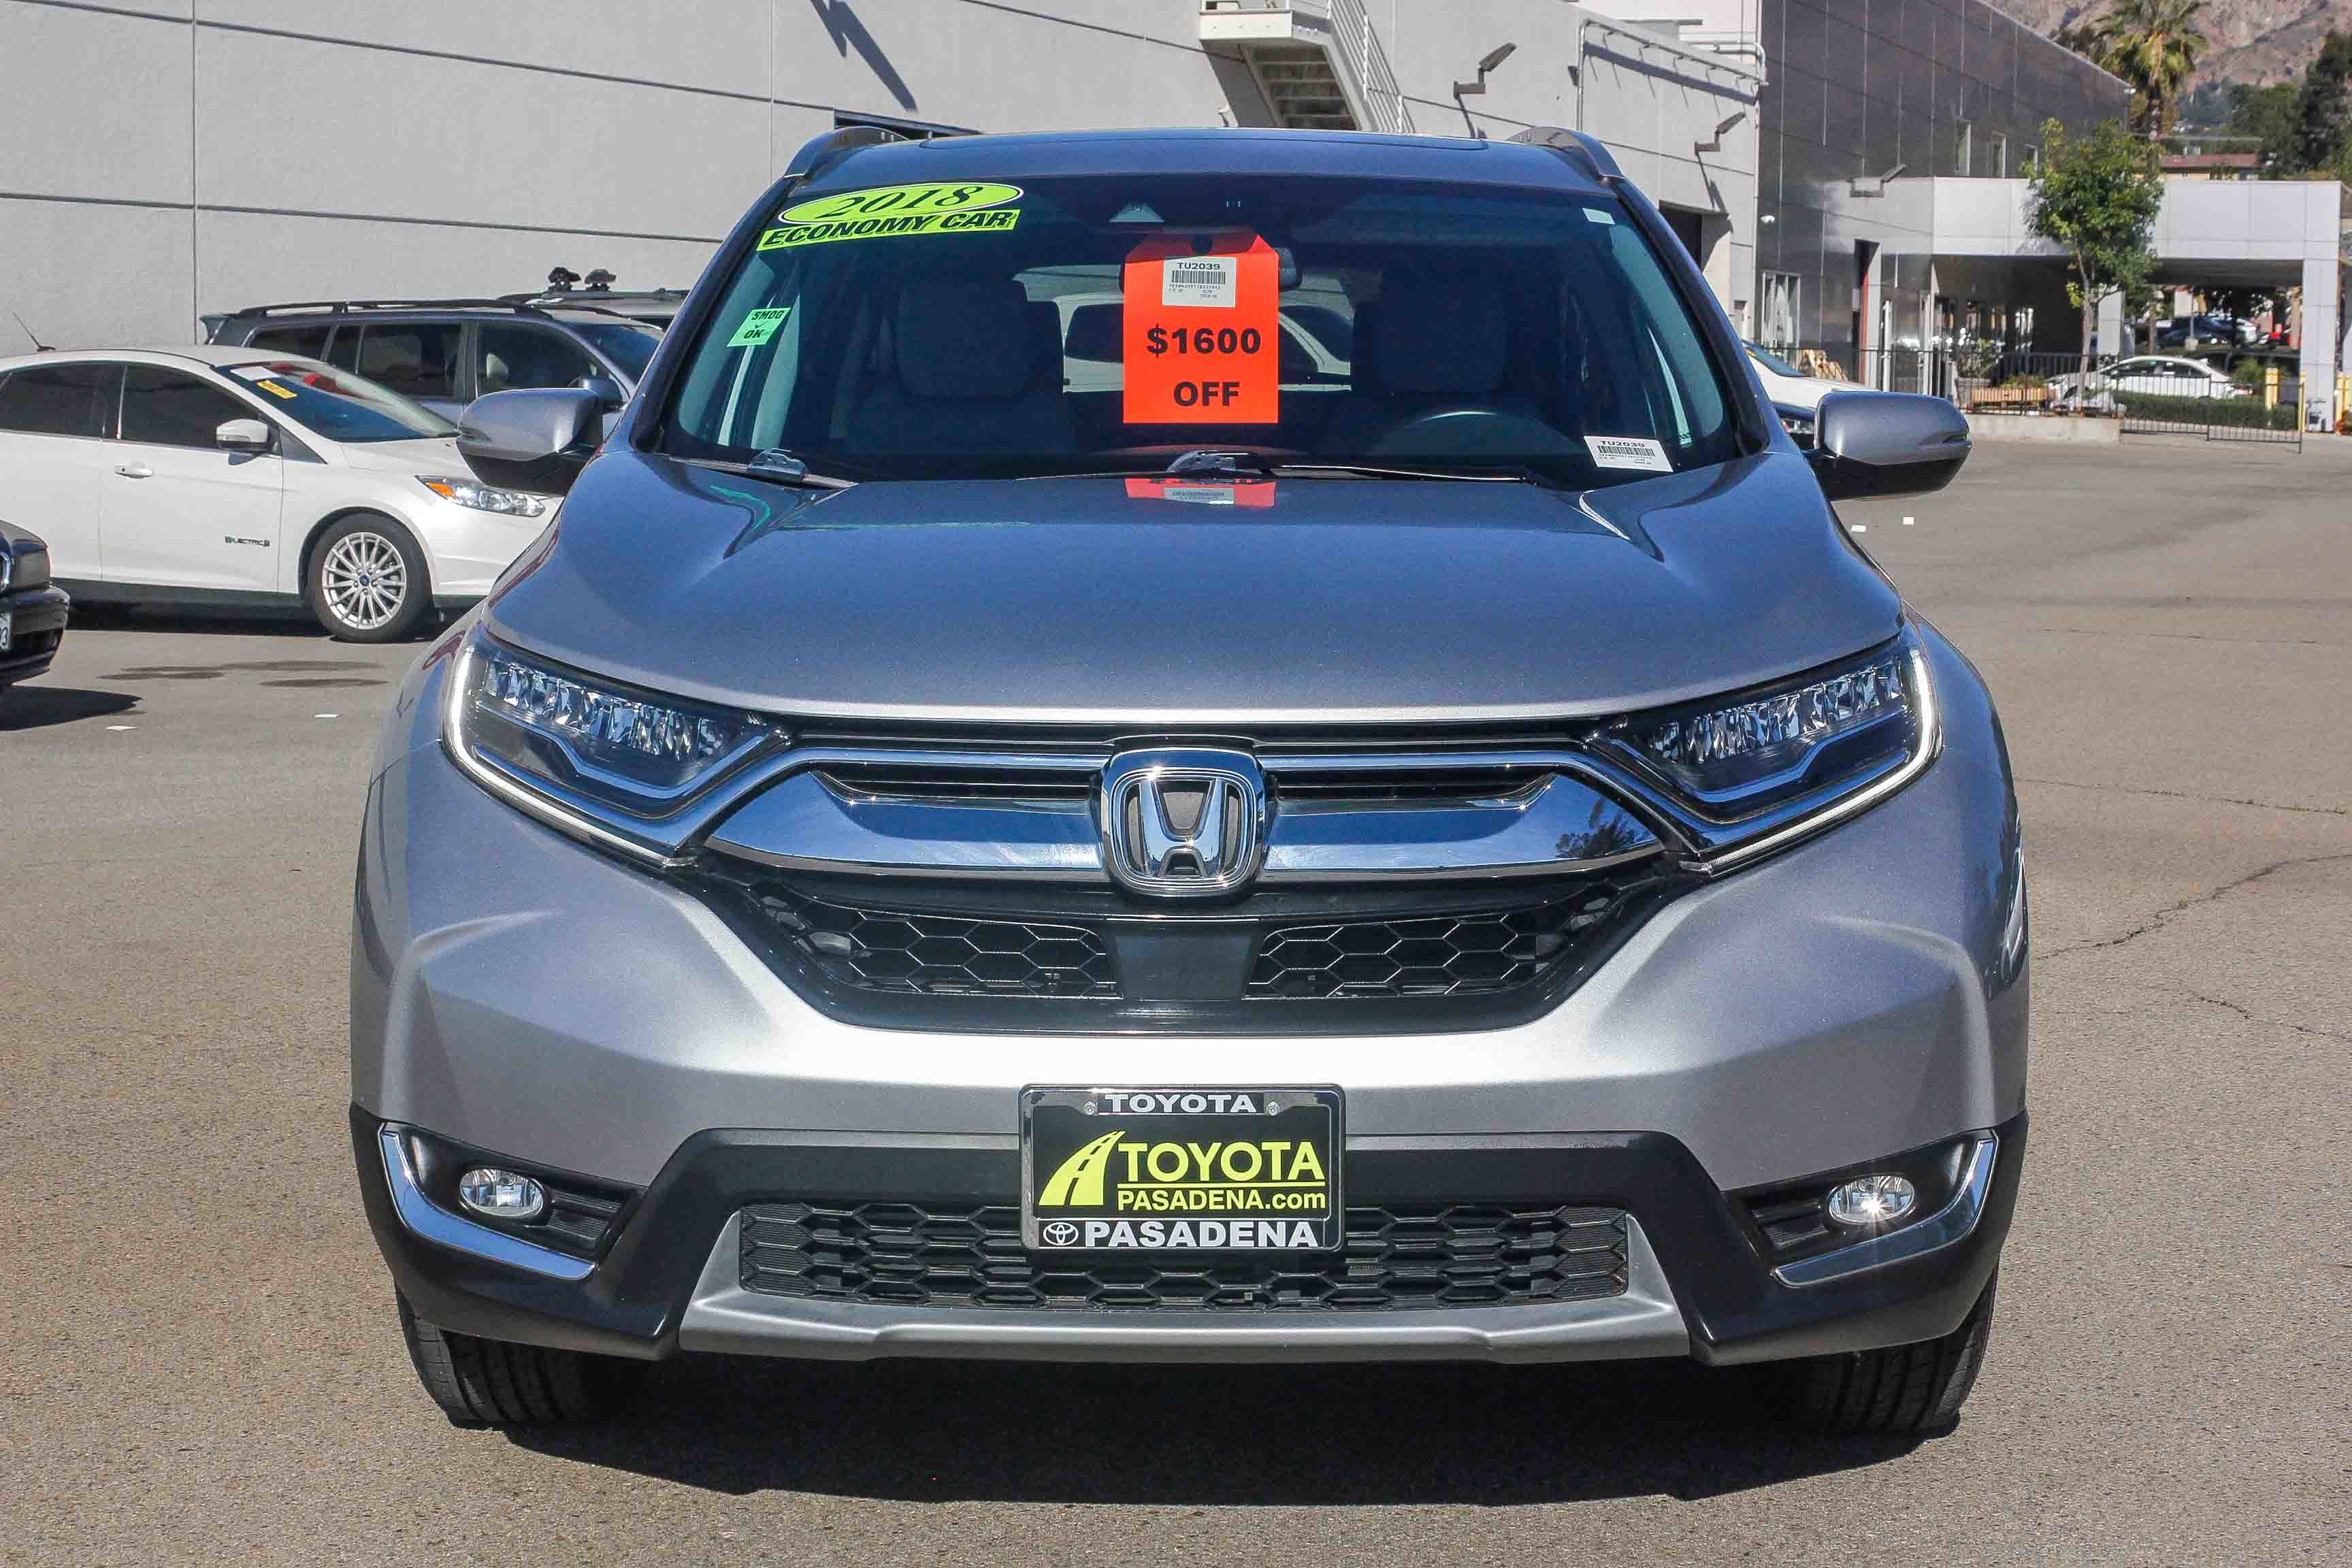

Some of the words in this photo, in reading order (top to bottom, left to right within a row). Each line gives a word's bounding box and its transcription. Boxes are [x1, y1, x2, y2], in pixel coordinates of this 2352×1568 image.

[816, 186, 984, 218] 2018
[763, 214, 936, 247] ECONOMY
[941, 210, 1012, 230] CAR
[1177, 262, 1220, 270] TU2039
[751, 310, 785, 321] SMOG
[744, 329, 766, 338] OK
[1146, 323, 1261, 358] $1600
[1173, 381, 1240, 406] OFF
[1104, 1094, 1258, 1113] TOYOTA
[1117, 1141, 1326, 1183] TOYOTA
[1117, 1189, 1326, 1211] PASADENA.com
[1085, 1220, 1319, 1248] PASADENA
